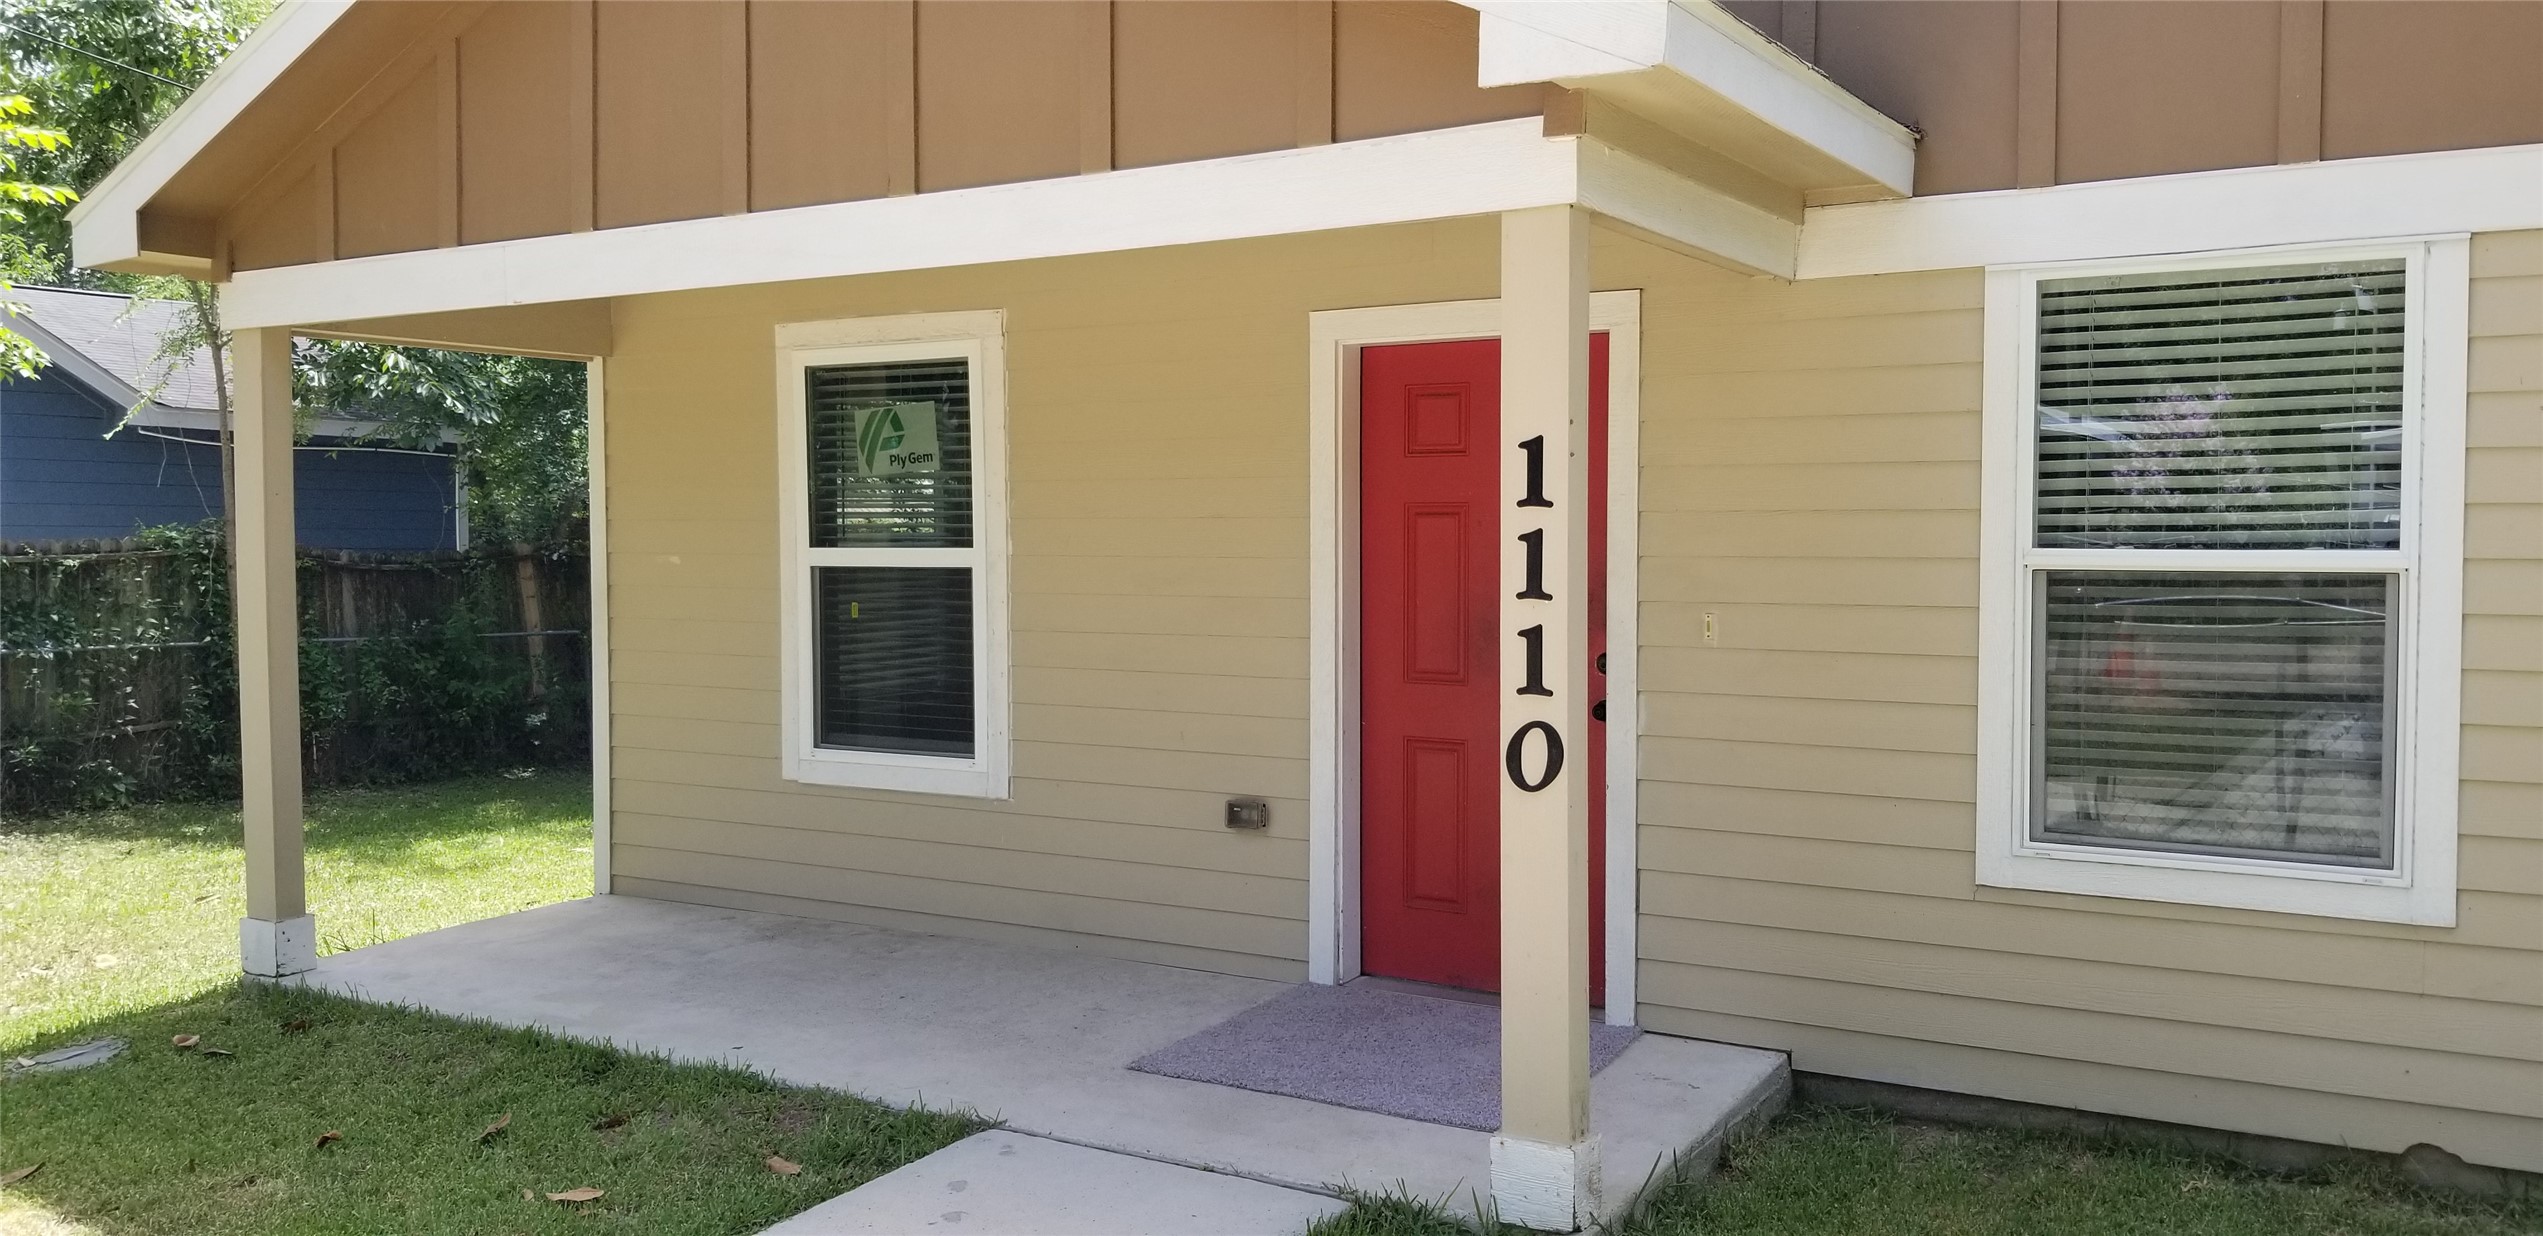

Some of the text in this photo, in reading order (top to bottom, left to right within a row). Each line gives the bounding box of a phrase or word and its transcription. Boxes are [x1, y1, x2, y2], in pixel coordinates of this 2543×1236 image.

[889, 452, 934, 470] Ply Gem
[1506, 434, 1564, 793] 1110
